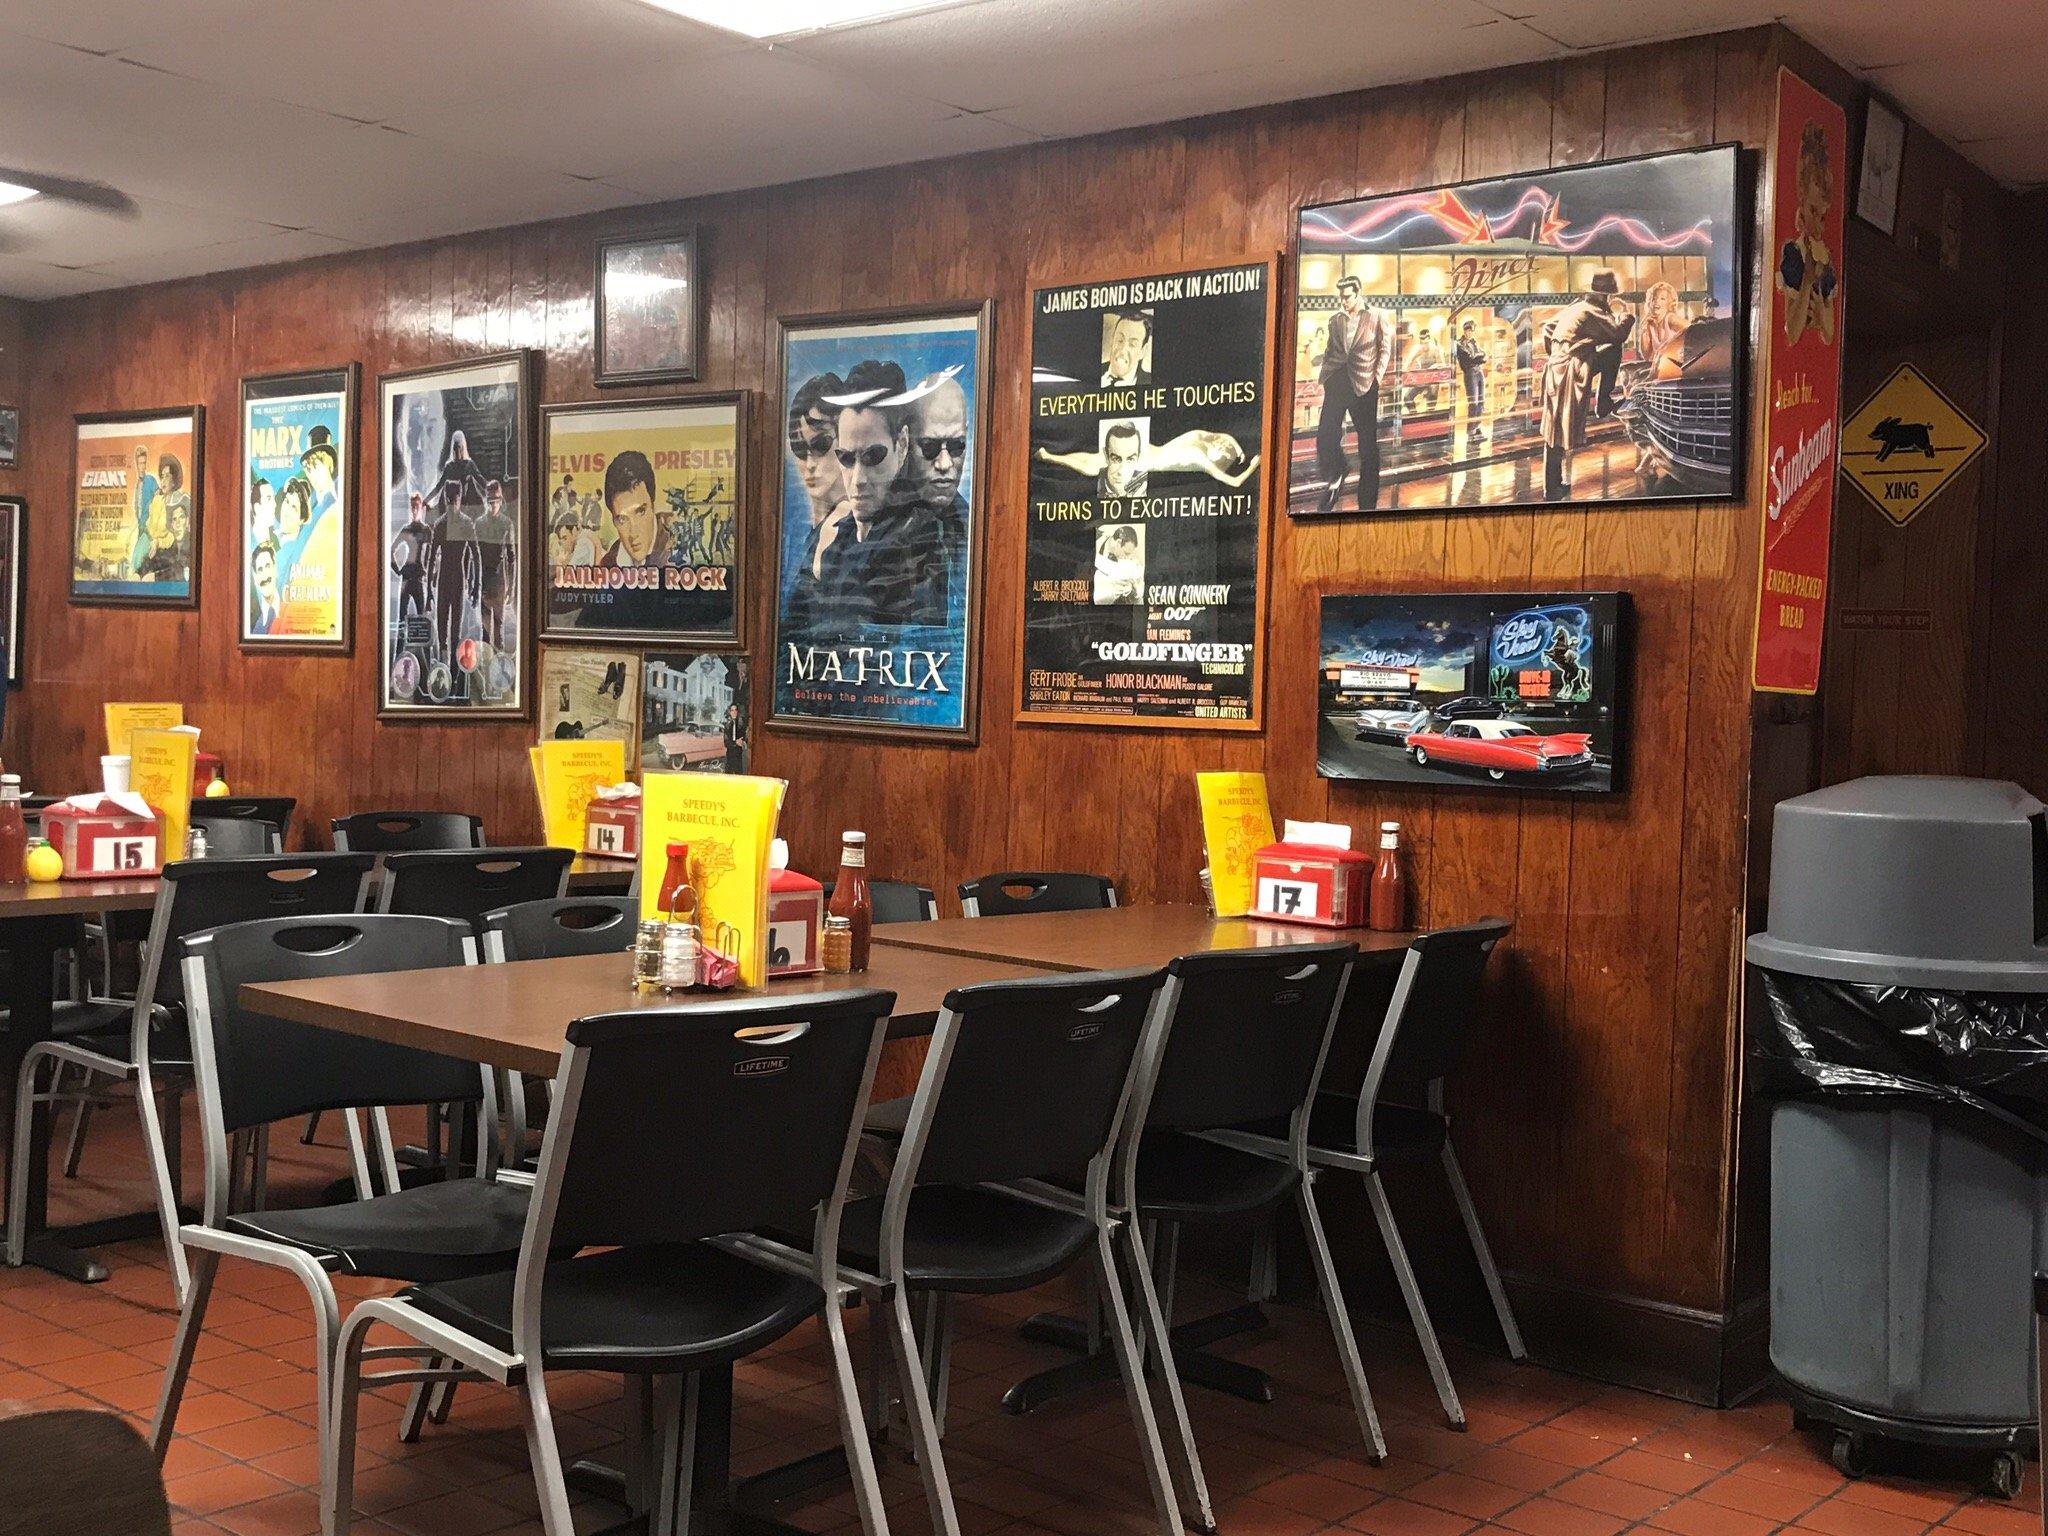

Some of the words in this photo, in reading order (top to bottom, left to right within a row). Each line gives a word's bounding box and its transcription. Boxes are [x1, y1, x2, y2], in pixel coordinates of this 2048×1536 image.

[1043, 290, 1088, 313] JAMES
[1091, 285, 1127, 308] BOND
[1130, 283, 1142, 304] IS
[1146, 278, 1182, 303] BACK
[1186, 276, 1200, 298] IN
[1203, 269, 1260, 297] ACTION!
[1040, 391, 1136, 416] EVERYTHING
[1144, 388, 1166, 409] HE
[1174, 382, 1255, 407] TOUCHES
[251, 425, 303, 457] MARX
[551, 453, 605, 473] ELVIS
[654, 448, 736, 470] PRESLEY
[1769, 418, 1832, 521] Sunbeam
[81, 470, 127, 488] GIANT
[1884, 482, 1919, 499] XING
[1037, 501, 1092, 521] TURNS
[1101, 500, 1122, 520] TO
[1131, 495, 1251, 518] EXCITEMENT!
[554, 565, 659, 590] JAILHOUSE
[665, 565, 727, 591] ROCK
[1033, 580, 1053, 591] ALBERT
[1767, 568, 1823, 599] ENERGY-PACKED
[555, 593, 579, 604] JUDY
[582, 593, 614, 604] TYLER
[1148, 585, 1177, 605] SEAN
[1179, 584, 1231, 605] CONNERY
[1164, 606, 1206, 621] 007
[1779, 604, 1804, 629] BREAD
[1502, 619, 1539, 641] Sky
[1361, 650, 1386, 665] Sky
[1497, 635, 1542, 659] View
[786, 642, 950, 691] MATRIX
[1030, 672, 1051, 687] GERT
[1052, 672, 1077, 688] FROBE
[1105, 673, 1135, 689] HONOR
[1136, 674, 1182, 691] BLACKMAN
[795, 689, 833, 701] Believe
[839, 691, 856, 702] the
[863, 693, 937, 706] unbelievable.
[1195, 706, 1218, 718] UNITED
[1219, 706, 1247, 719] ARTISTS
[683, 798, 726, 812] SPEEDY'S
[667, 811, 719, 827] BARBECUE,
[721, 817, 740, 828] INC.
[597, 828, 615, 851] 14
[114, 842, 143, 869] 15
[1273, 884, 1302, 914] 17
[740, 1060, 784, 1072] LIFETIME
